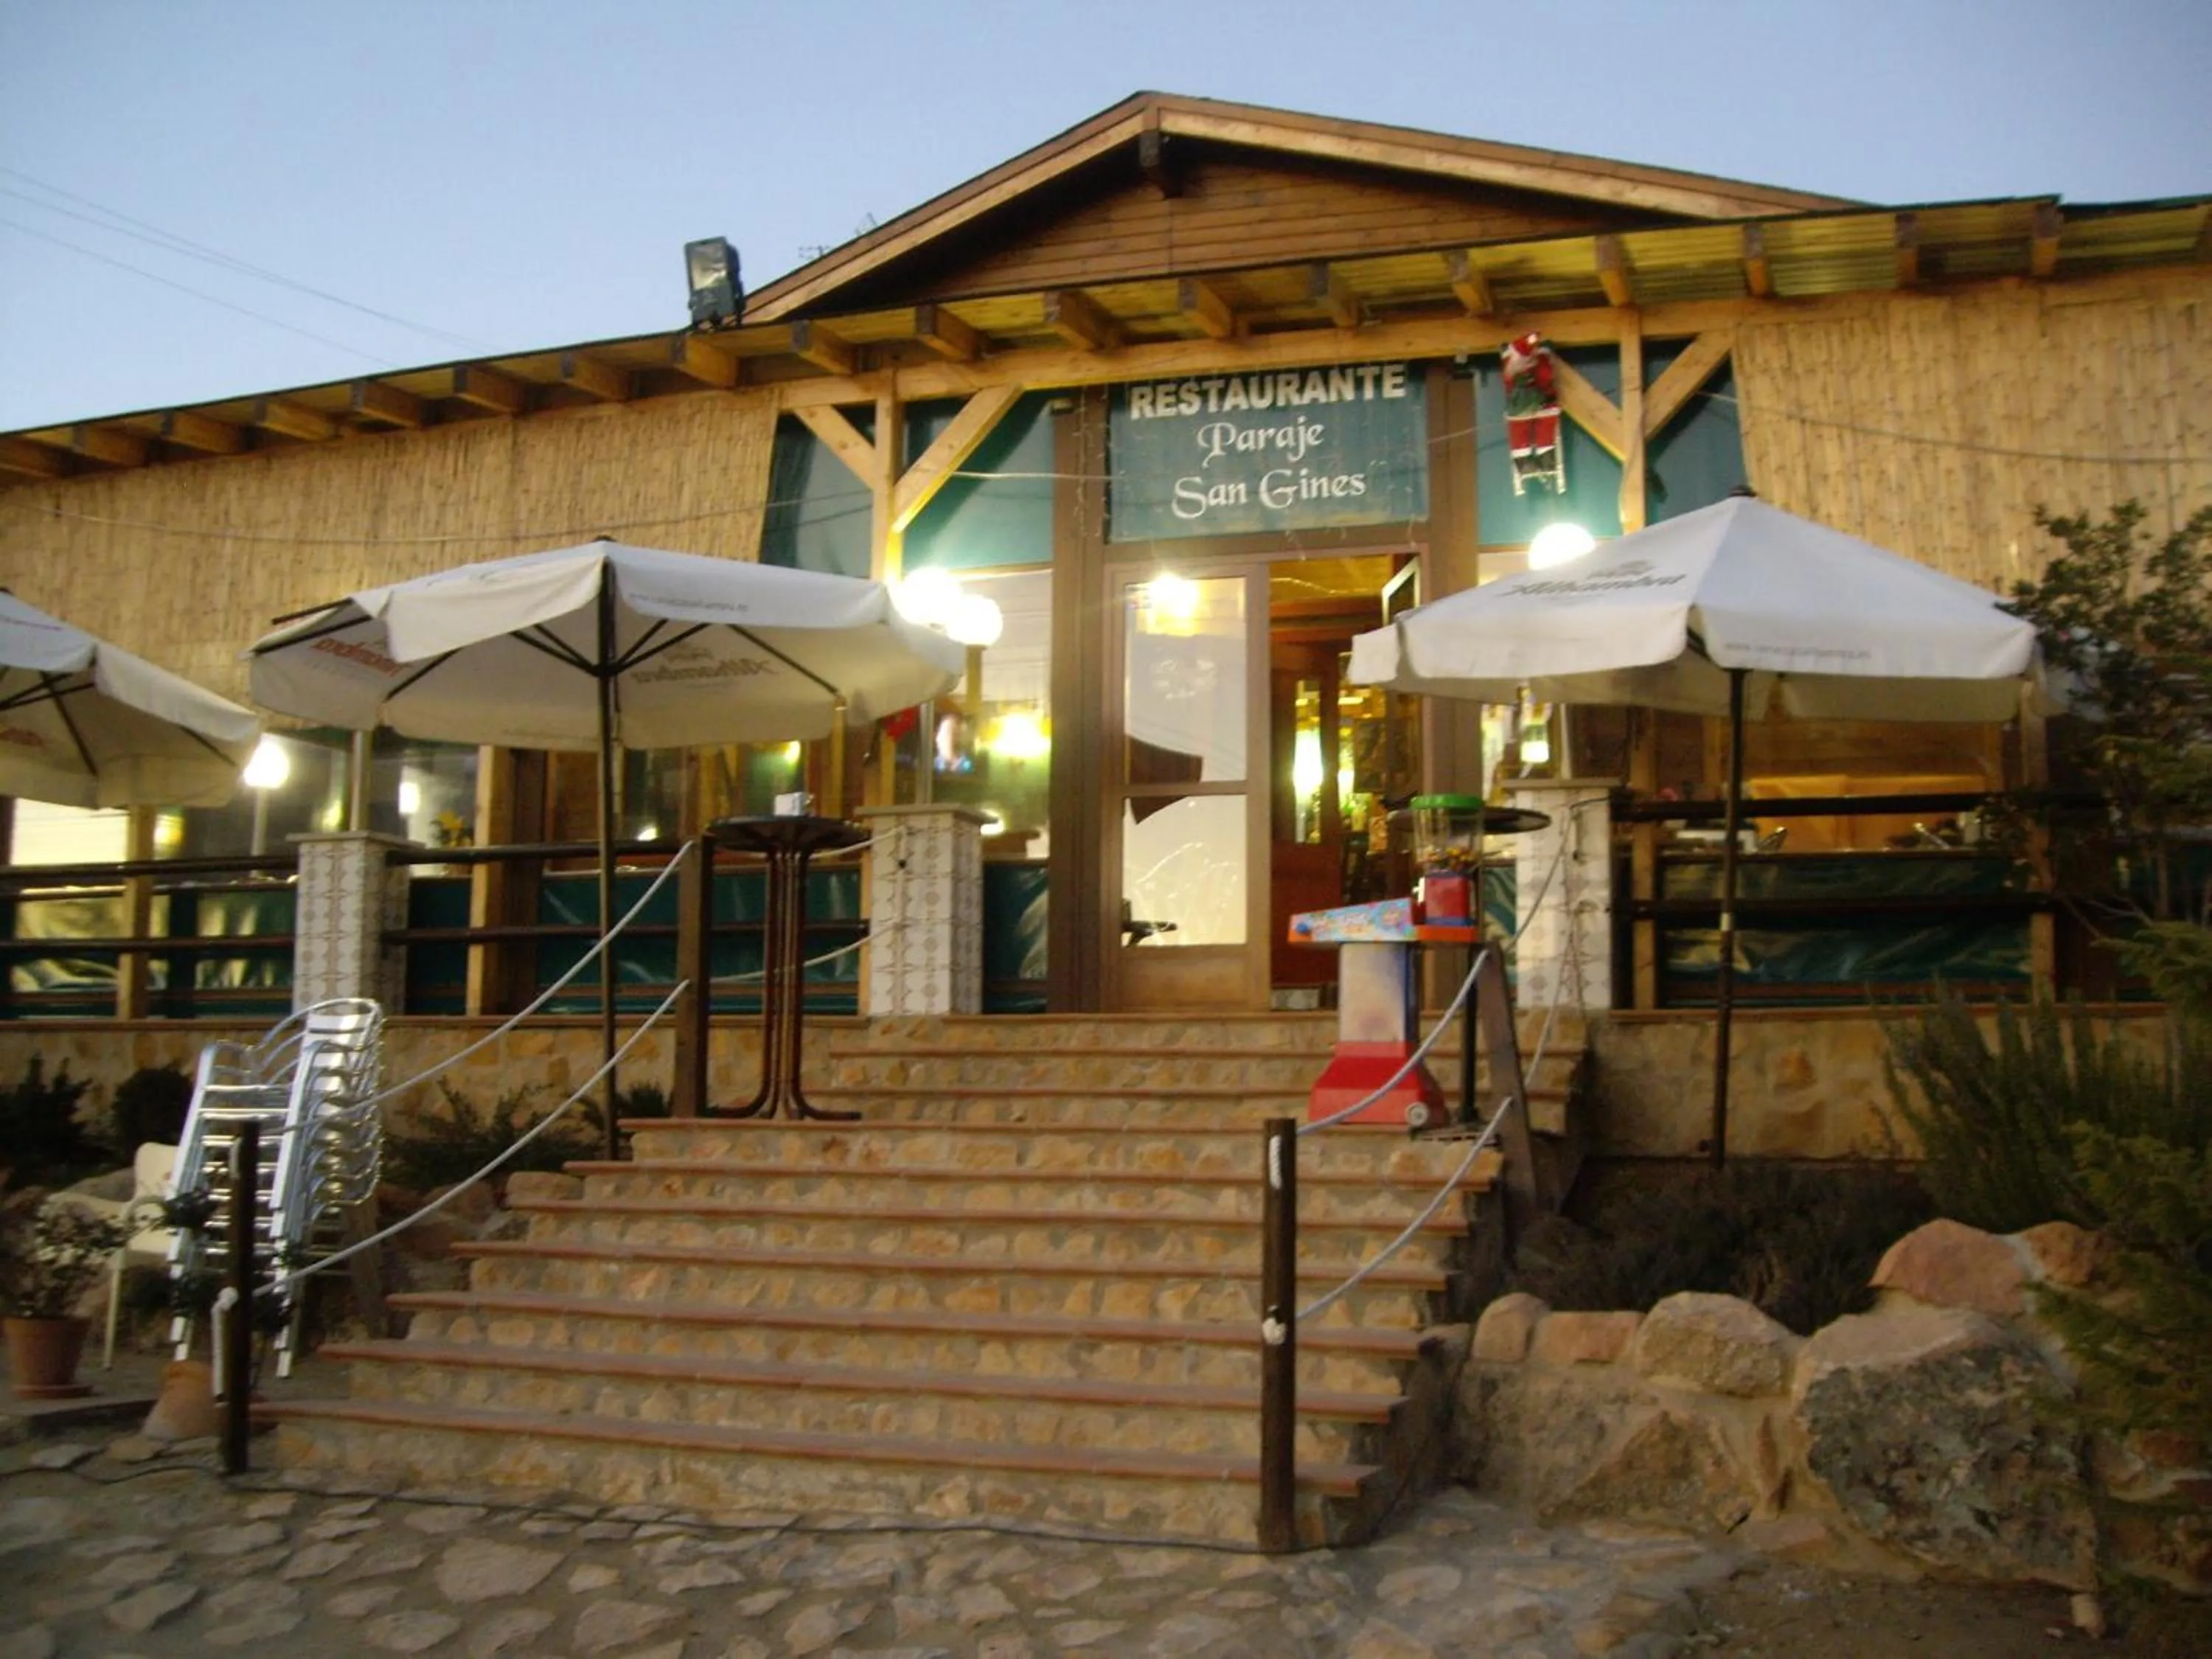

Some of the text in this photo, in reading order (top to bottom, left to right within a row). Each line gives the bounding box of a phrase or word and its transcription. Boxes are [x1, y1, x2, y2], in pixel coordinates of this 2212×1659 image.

[1130, 364, 1406, 421] RESTAURANTE
[1197, 415, 1325, 469] Paraje
[1172, 467, 1367, 519] San Gines
